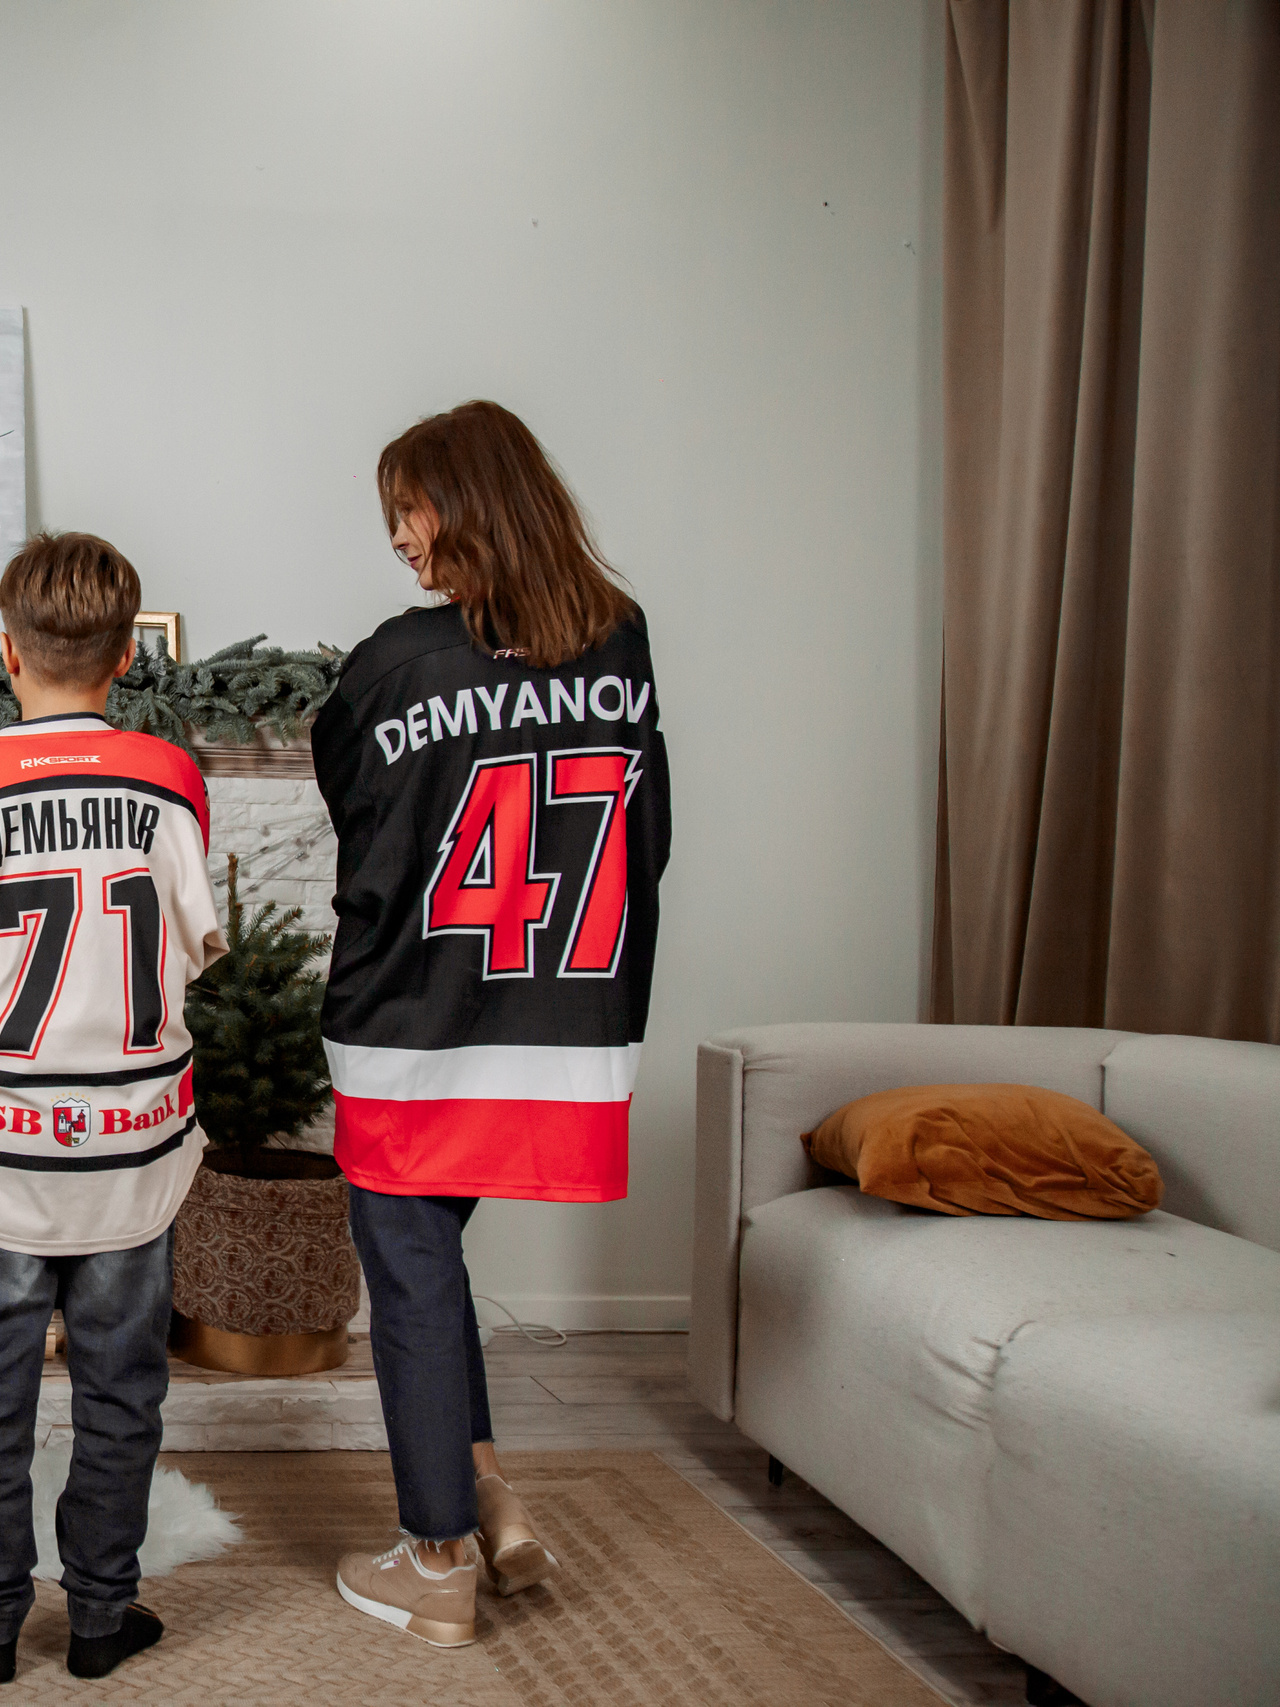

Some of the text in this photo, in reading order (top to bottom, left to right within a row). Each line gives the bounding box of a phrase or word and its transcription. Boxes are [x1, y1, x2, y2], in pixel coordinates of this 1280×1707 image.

[375, 675, 650, 765] DEMYANOV
[422, 746, 643, 981] 47
[98, 1093, 176, 1136] Bank
